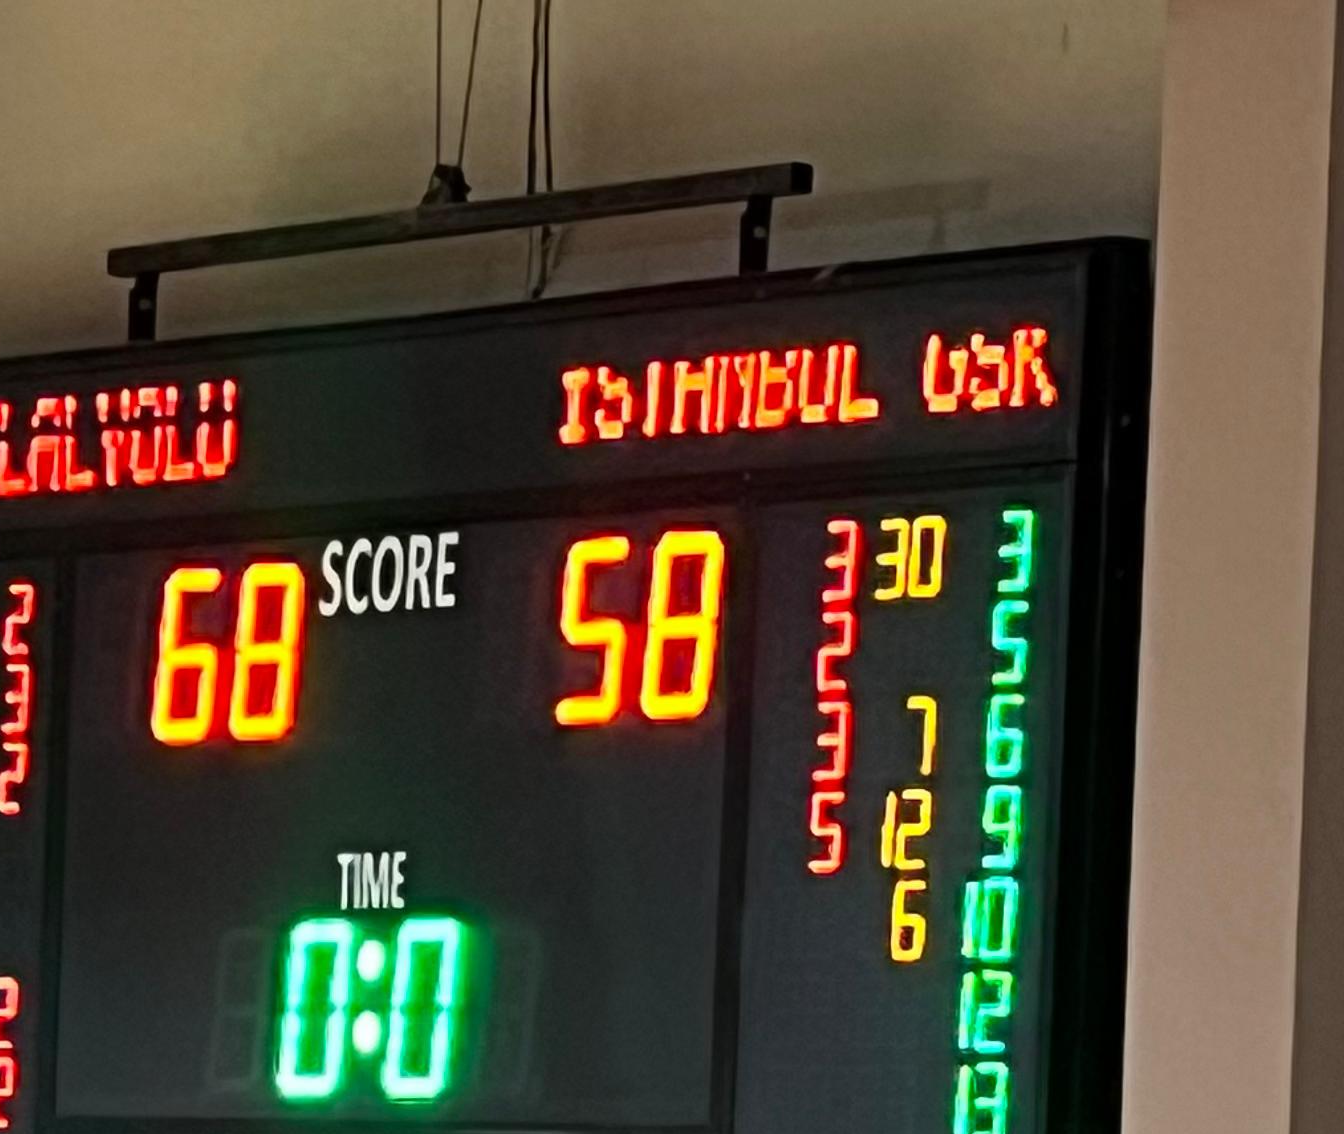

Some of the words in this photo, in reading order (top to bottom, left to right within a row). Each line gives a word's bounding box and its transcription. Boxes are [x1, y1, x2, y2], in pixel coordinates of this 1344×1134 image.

[319, 531, 459, 617] SCORE
[822, 520, 858, 602] 3
[874, 514, 947, 601] 30
[997, 510, 1034, 592] 3
[2, 583, 34, 654] 2
[150, 562, 306, 746] 68
[555, 530, 725, 726] 58
[817, 611, 852, 690] 2
[992, 601, 1029, 685] 5
[1, 664, 30, 733] 3
[812, 700, 851, 780] 3
[906, 696, 937, 775] 7
[986, 693, 1025, 778] 6
[808, 791, 845, 874] 5
[880, 788, 932, 871] 12
[982, 784, 1021, 870] 9
[338, 851, 407, 910] TIME
[890, 879, 926, 963] 6
[961, 876, 1019, 963] 10
[275, 917, 460, 1103] 0:0
[959, 969, 1013, 1053] 12
